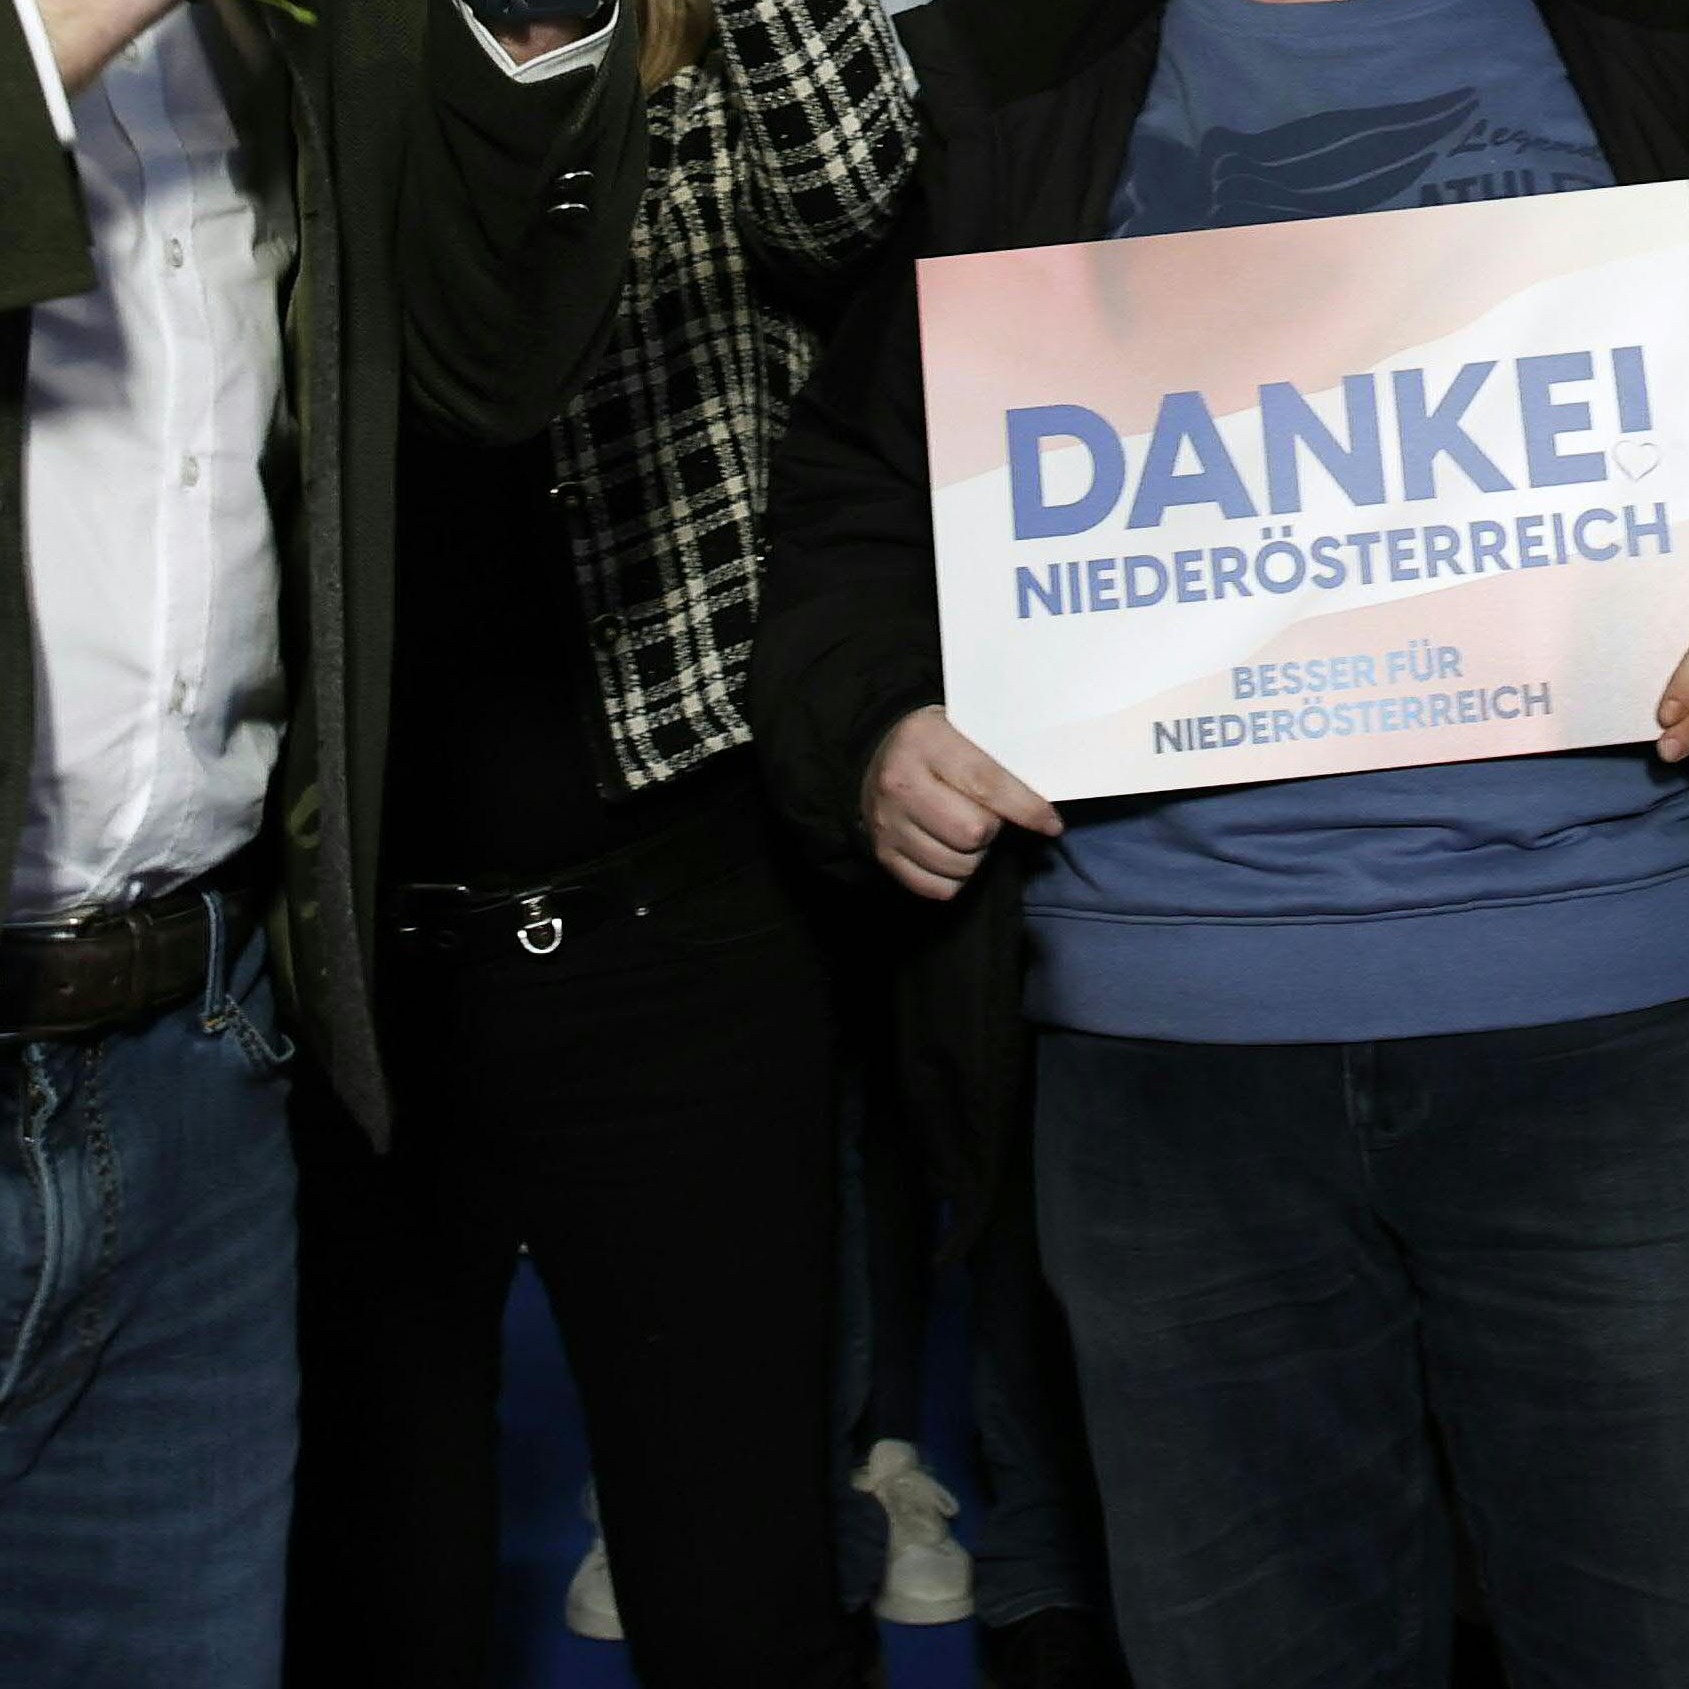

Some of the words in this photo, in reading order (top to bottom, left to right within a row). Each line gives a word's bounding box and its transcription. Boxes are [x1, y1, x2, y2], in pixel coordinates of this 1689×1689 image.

[1005, 344, 1662, 541] DANKE!
[1014, 501, 1673, 619] NIEDERÖSTERREICH
[1152, 681, 1553, 755] NIEDERÖSTERREICH
[1232, 653, 1378, 702] BESSER
[1386, 638, 1465, 684] FÜR
